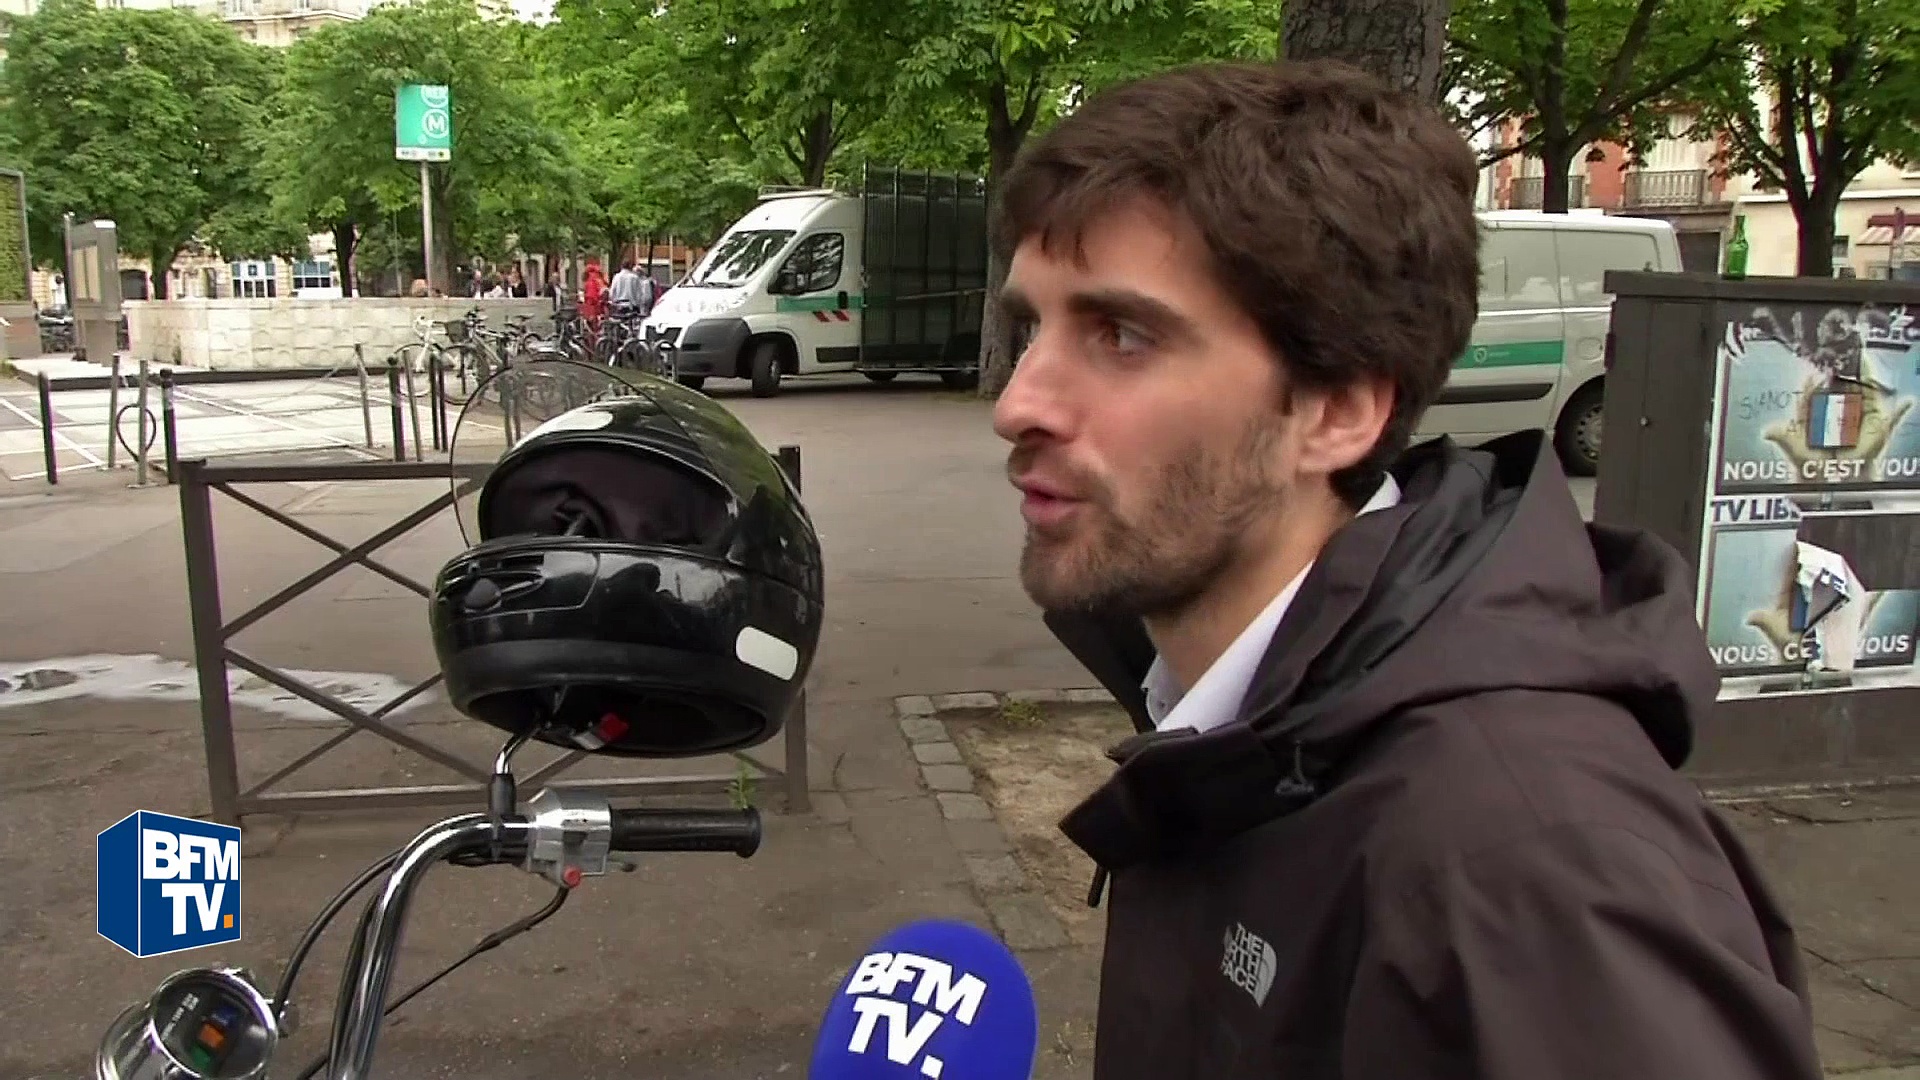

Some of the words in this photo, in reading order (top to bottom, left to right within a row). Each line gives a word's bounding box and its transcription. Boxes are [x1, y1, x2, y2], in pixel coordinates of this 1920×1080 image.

[428, 115, 445, 133] M
[1803, 458, 1866, 478] C'EST
[1873, 457, 1920, 478] VOU
[1710, 499, 1746, 522] TV
[1749, 498, 1799, 521] LIB
[1223, 930, 1261, 978] RTH
[845, 951, 988, 1027] BFM
